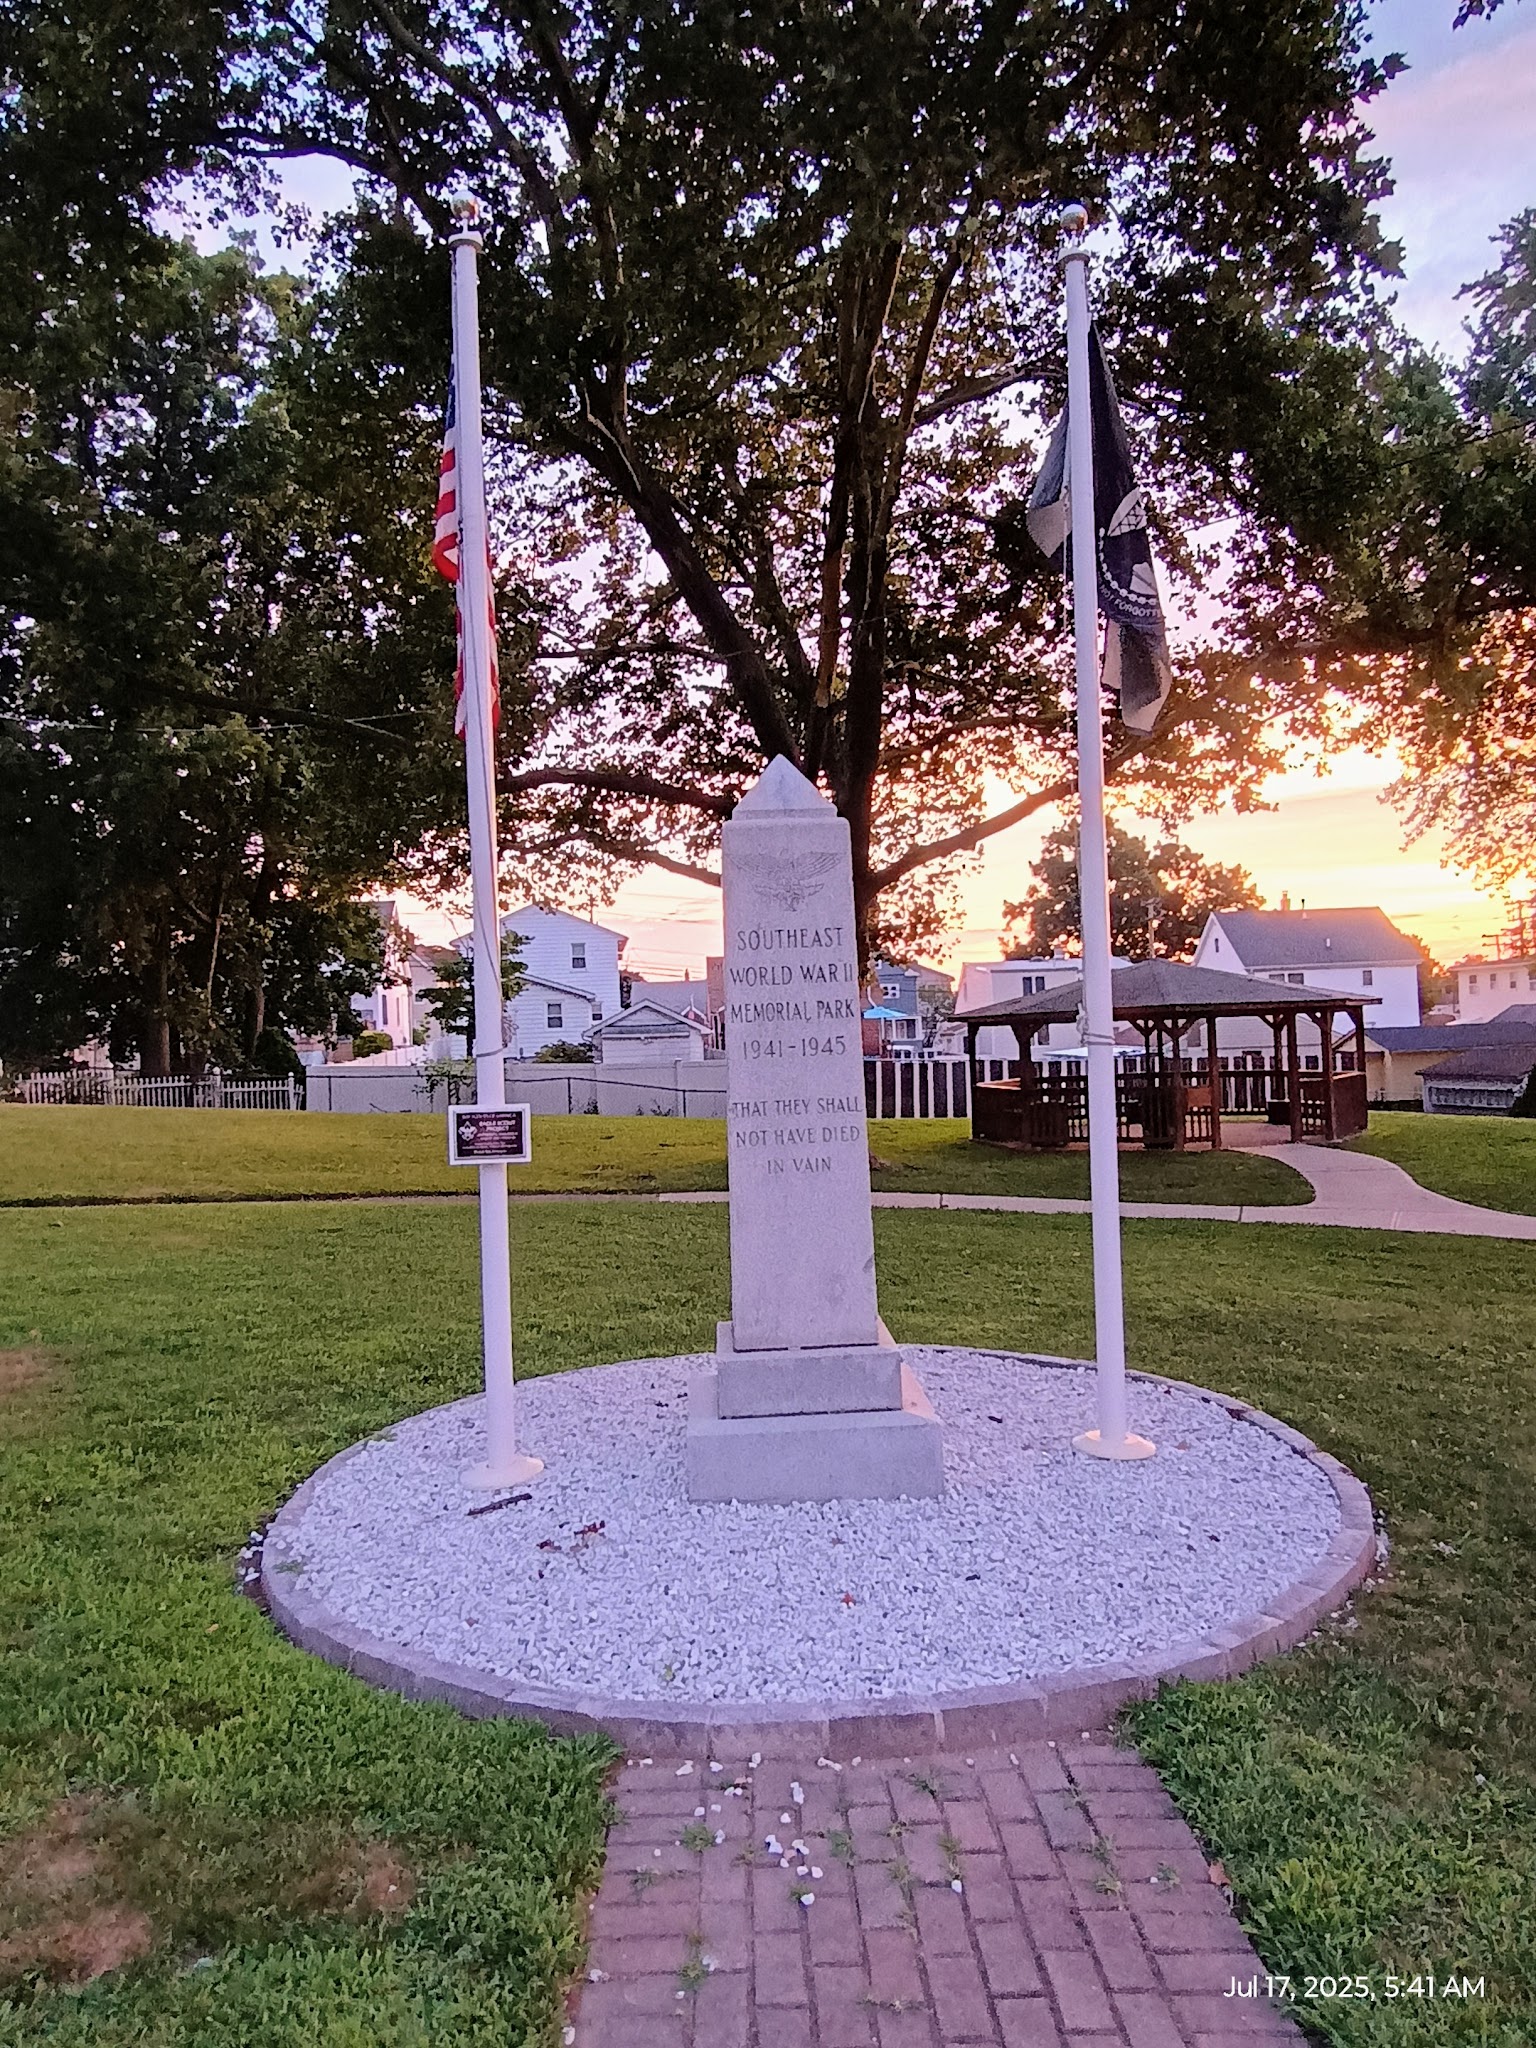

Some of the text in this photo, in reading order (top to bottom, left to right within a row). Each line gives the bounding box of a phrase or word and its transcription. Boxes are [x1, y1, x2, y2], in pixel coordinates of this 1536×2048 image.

[737, 927, 844, 951] SOUTHEAST
[729, 963, 853, 987] WORLD WAR II
[730, 998, 855, 1024] MEMORIAL PARK
[742, 1035, 847, 1060] 1941-1945
[732, 1096, 863, 1118] THAT THEY SHALL
[736, 1126, 860, 1148] NOT HAVE DIED
[767, 1157, 832, 1174] IN VAIN
